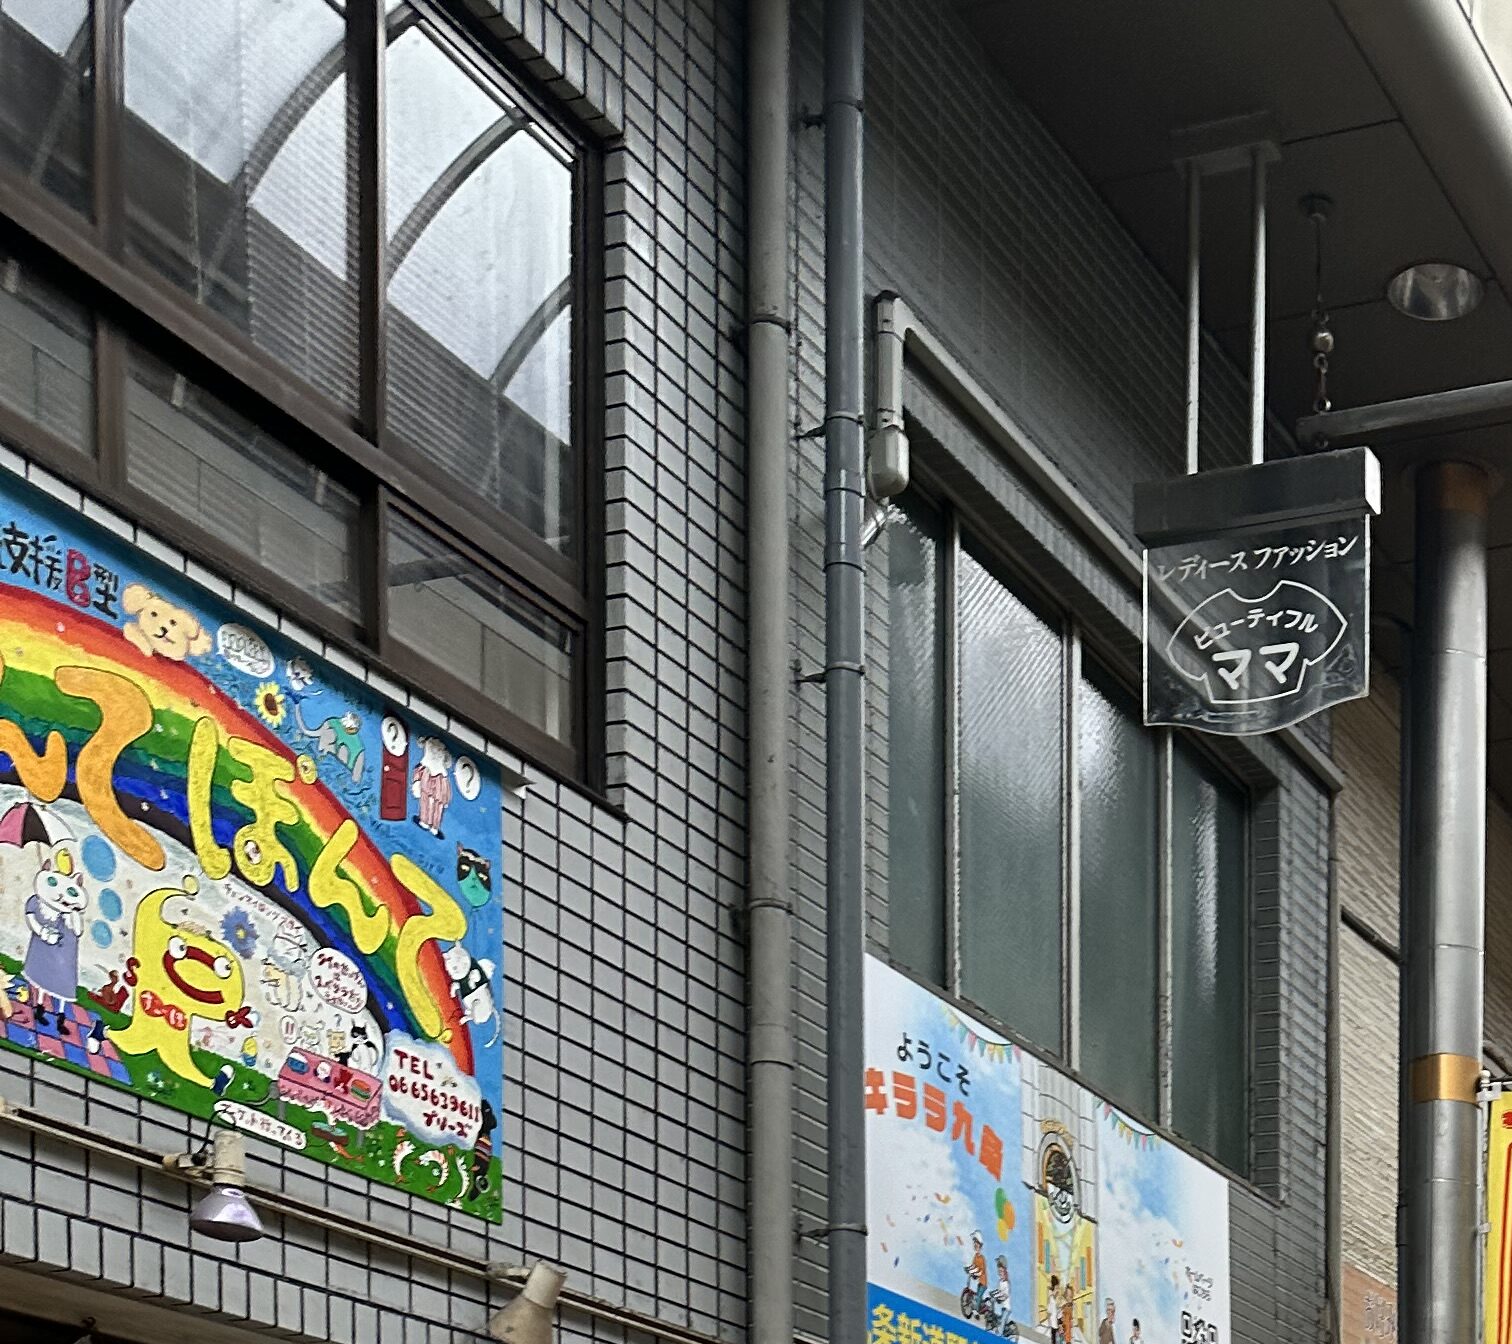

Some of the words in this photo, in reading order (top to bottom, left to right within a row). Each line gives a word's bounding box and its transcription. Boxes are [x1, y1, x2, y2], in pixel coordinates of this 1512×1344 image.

[0, 521, 119, 619] 支援B型
[1157, 551, 1248, 582] レディース
[1254, 535, 1359, 570] ファッション
[1213, 643, 1299, 690] ママ
[394, 1048, 434, 1080] TEL
[897, 1032, 971, 1096] ようこそ
[423, 1110, 473, 1138] プリーズ
